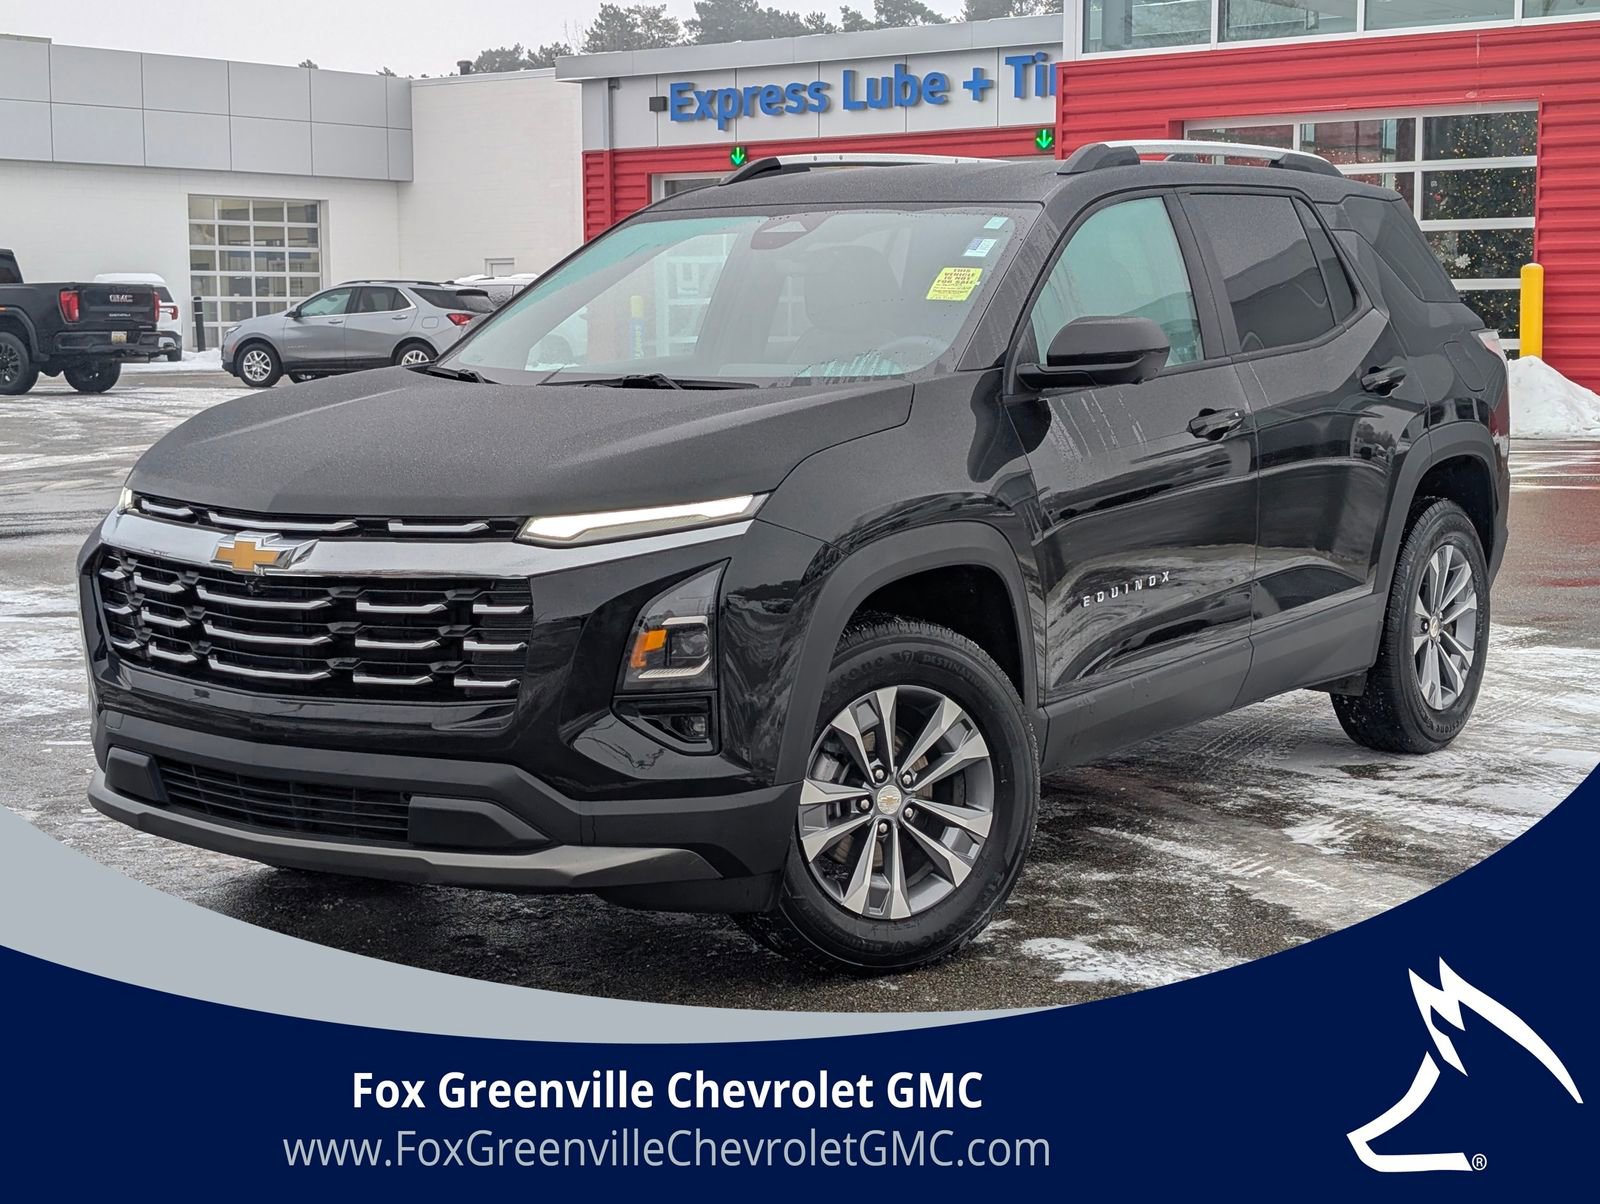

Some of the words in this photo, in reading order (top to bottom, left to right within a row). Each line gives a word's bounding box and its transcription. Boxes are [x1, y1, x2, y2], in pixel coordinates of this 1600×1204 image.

[669, 80, 830, 131] Express
[842, 63, 951, 112] Lube
[1082, 571, 1169, 607] EQUINOX
